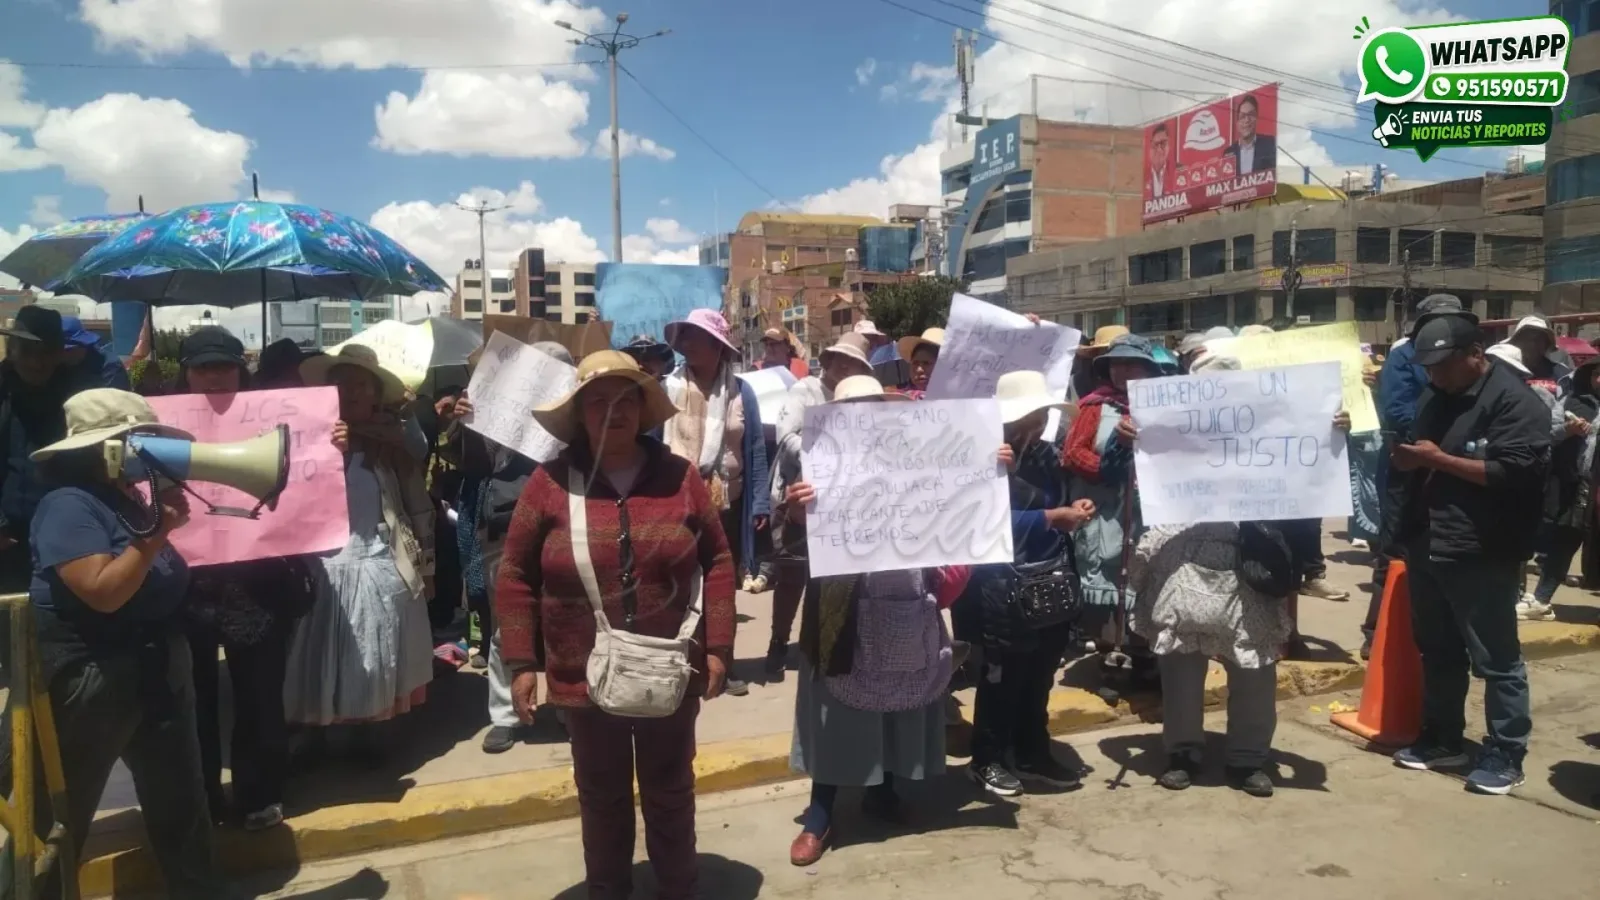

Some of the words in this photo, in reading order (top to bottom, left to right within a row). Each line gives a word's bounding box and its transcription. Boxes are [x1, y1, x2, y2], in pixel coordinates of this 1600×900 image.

[1205, 181, 1231, 197] MAX
[1233, 171, 1274, 190] LANZA
[1144, 192, 1188, 214] PANDIA
[1134, 377, 1228, 410] QUEREMOS
[1258, 371, 1288, 397] UN
[812, 410, 885, 434] MIGUEL
[898, 408, 951, 426] CANO
[1178, 404, 1255, 435] JUICIO
[1206, 435, 1319, 468] JUSTO
[954, 467, 998, 487] COMO
